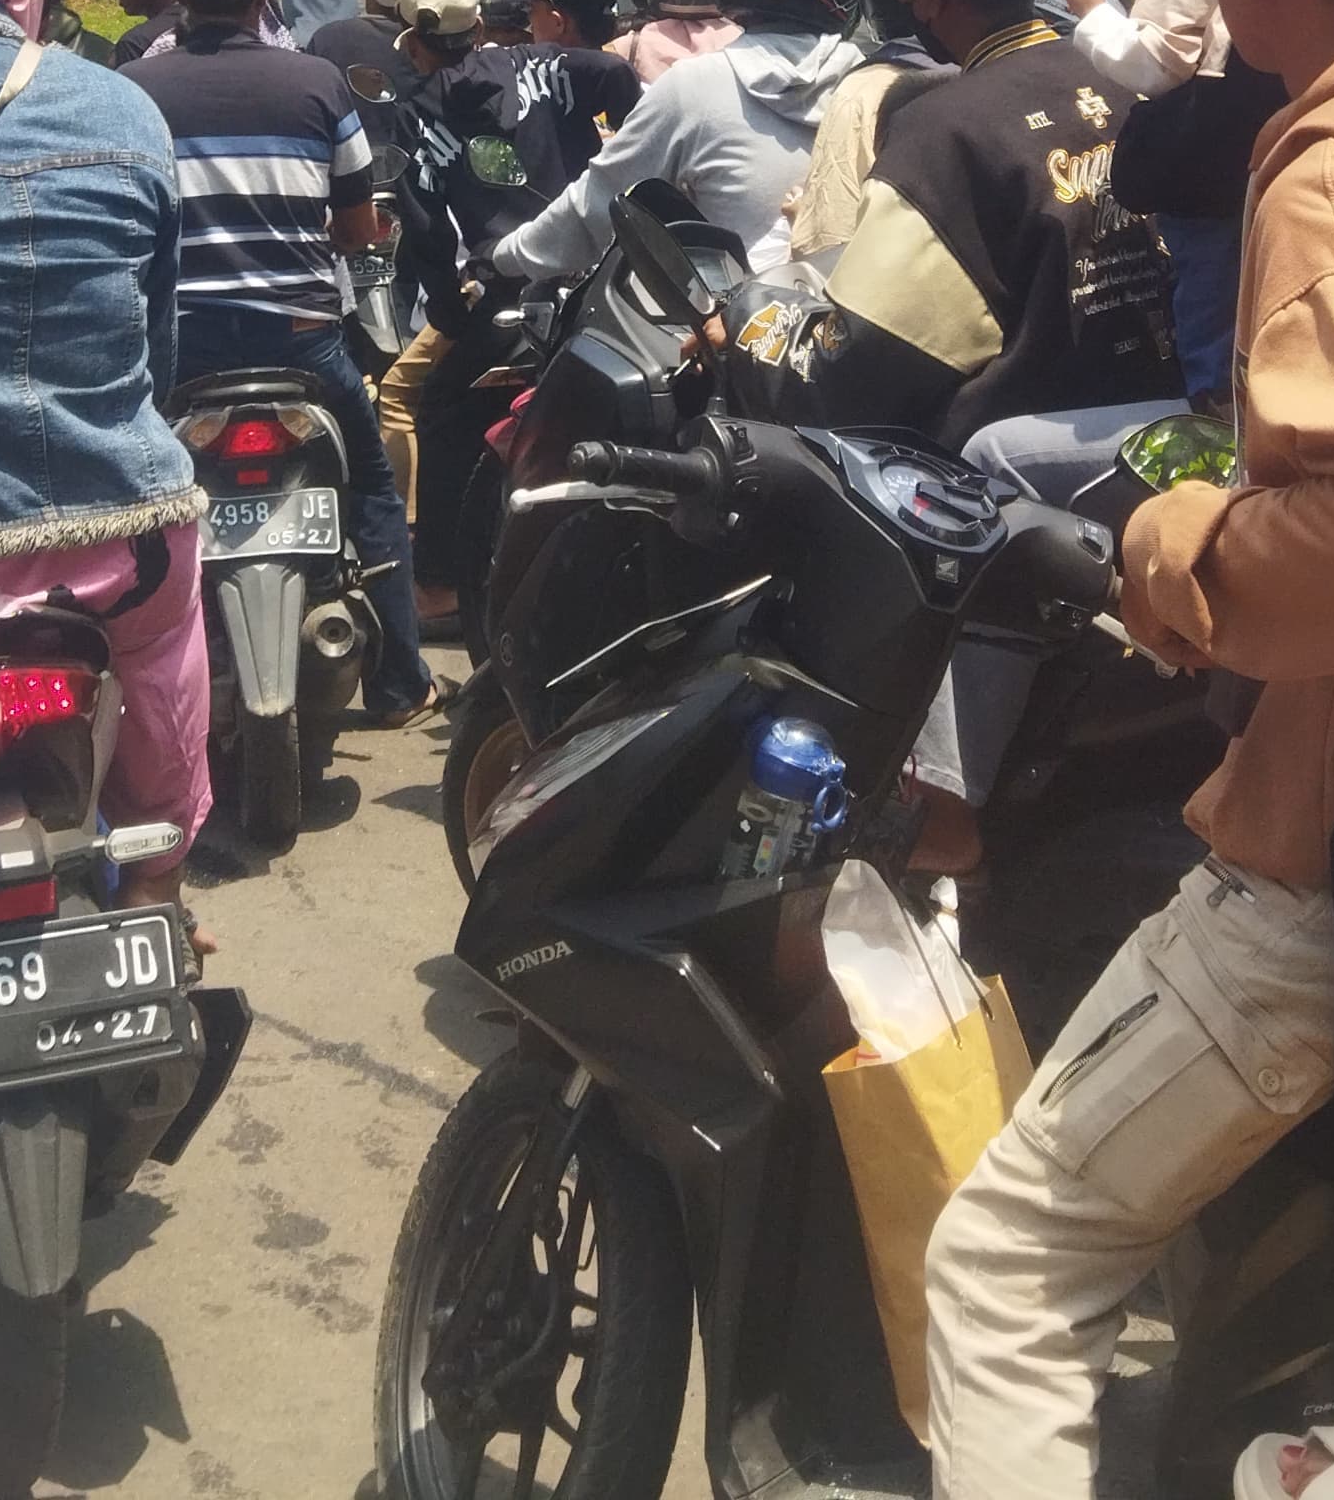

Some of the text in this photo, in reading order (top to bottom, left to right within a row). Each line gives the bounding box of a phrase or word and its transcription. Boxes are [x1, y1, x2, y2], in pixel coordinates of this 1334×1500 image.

[210, 495, 331, 527] 4958 JE
[104, 934, 159, 989] JD
[496, 940, 574, 981] HONDA
